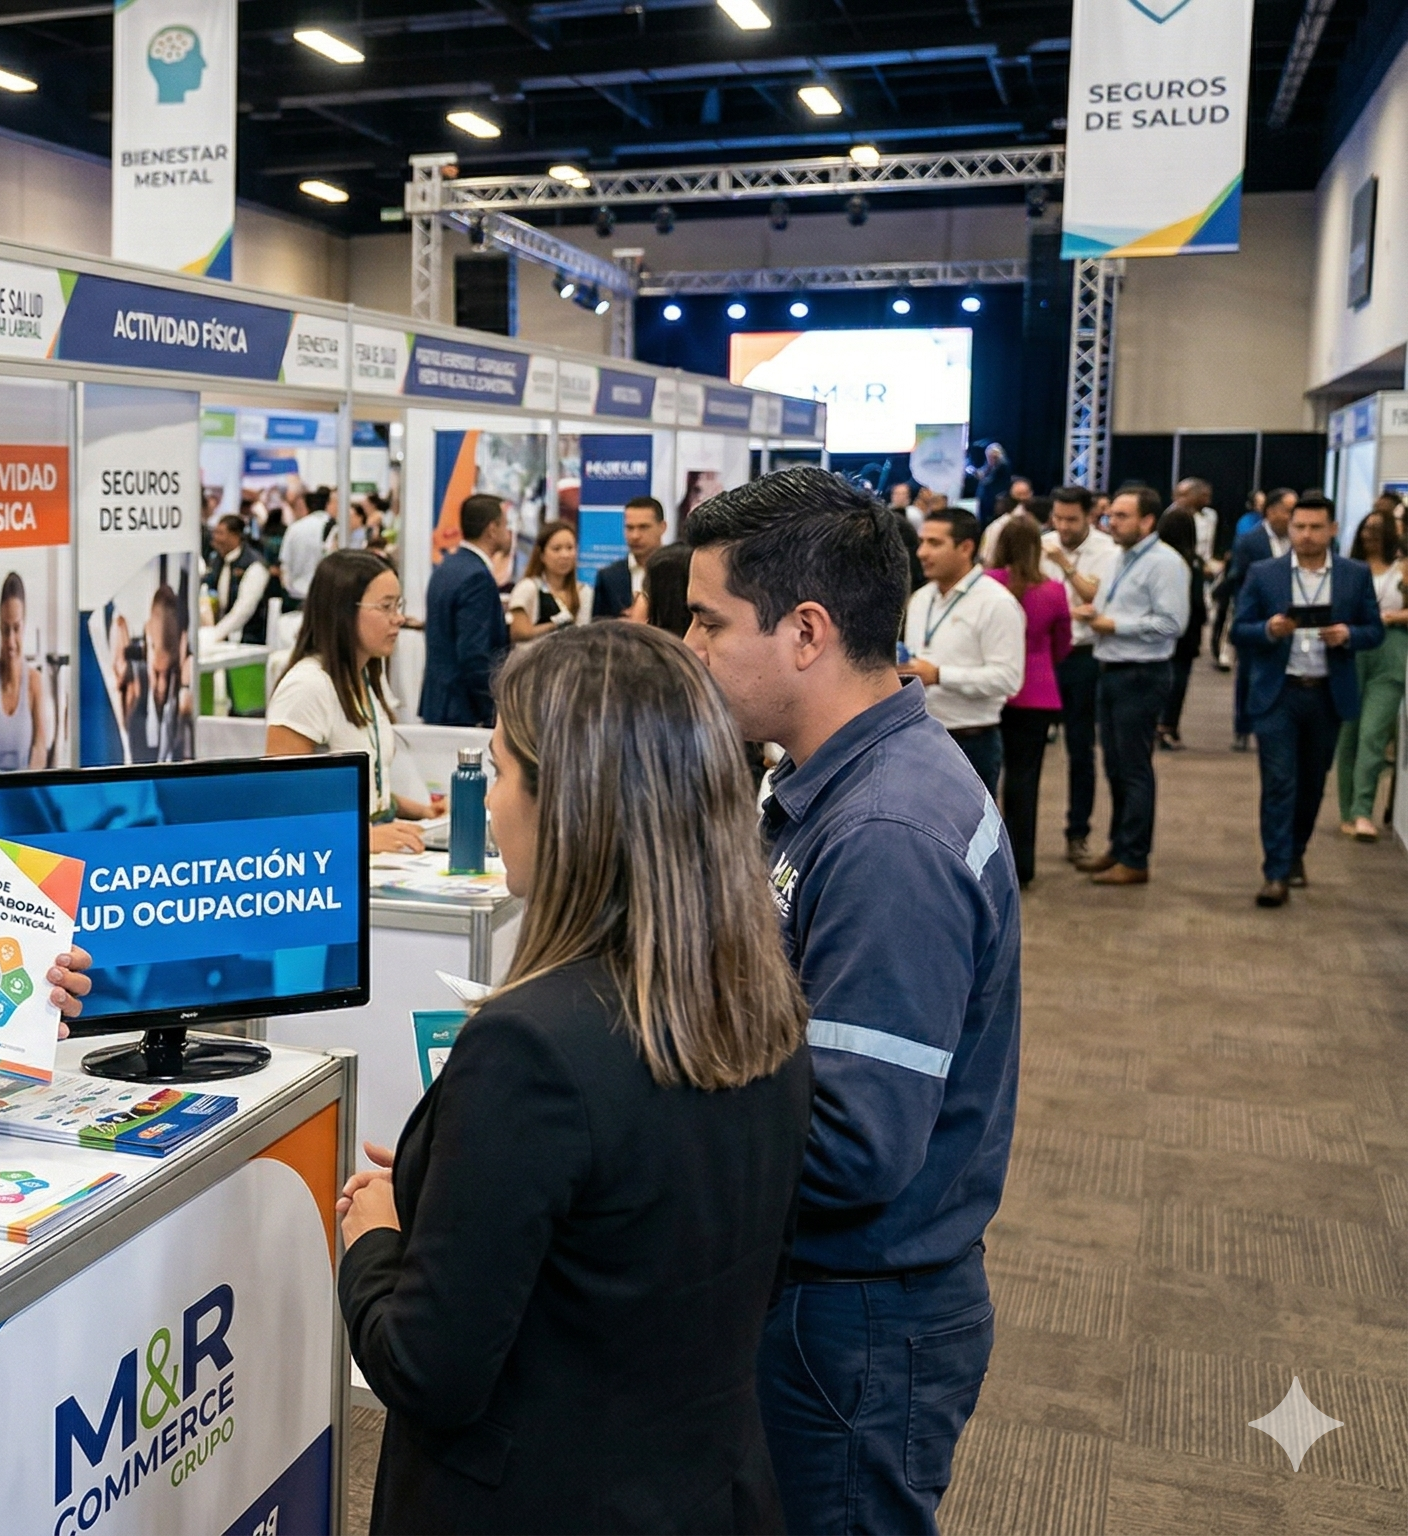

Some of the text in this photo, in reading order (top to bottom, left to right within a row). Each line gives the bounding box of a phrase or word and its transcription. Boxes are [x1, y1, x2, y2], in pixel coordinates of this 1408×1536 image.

[1089, 76, 1227, 103] SEGUROS
[1085, 105, 1230, 131] DE SALUD
[121, 144, 228, 167] BIENESTAR
[134, 168, 213, 188] MENTAL
[114, 311, 247, 353] ACTIVIDAD FÍSICA
[812, 382, 886, 402] MR
[102, 470, 180, 495] SEGUROS
[100, 505, 182, 531] DE SALUD
[89, 848, 332, 893] CAPACITACIÓN Y
[132, 886, 342, 927] OCUPACIONAL
[55, 1284, 234, 1506] M&R
[55, 1371, 234, 1536] COMMERCE
[171, 1416, 234, 1487] GRUPO
